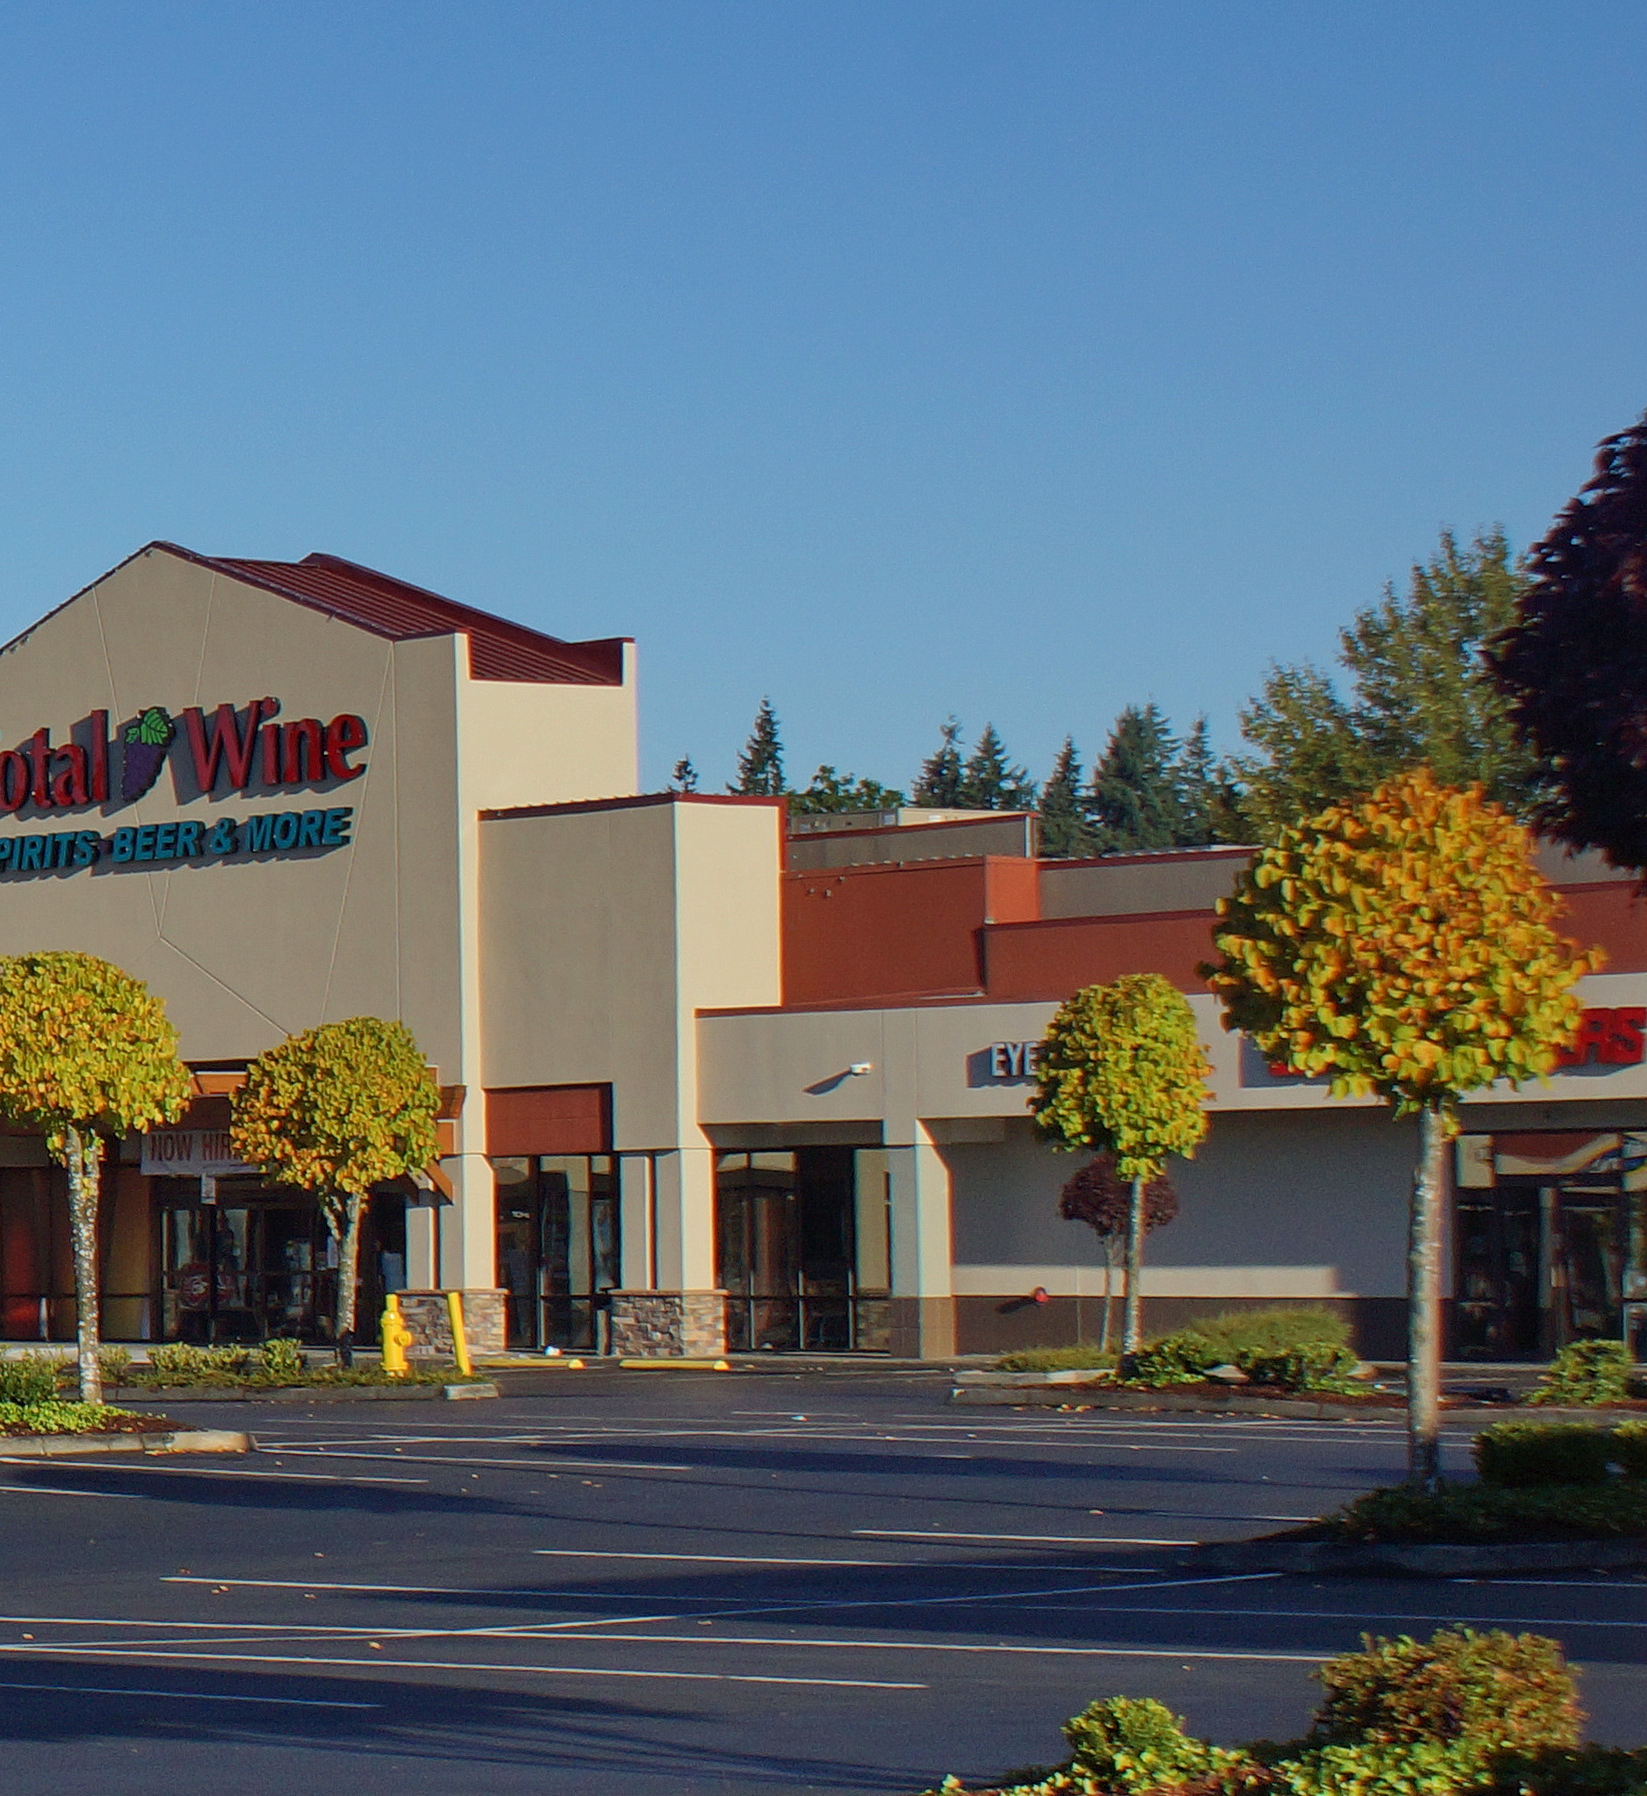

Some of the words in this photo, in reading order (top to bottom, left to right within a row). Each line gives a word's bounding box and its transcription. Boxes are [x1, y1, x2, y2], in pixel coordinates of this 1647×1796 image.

[182, 696, 369, 793] Wine
[209, 816, 239, 856] &
[245, 805, 355, 854] MORE
[150, 1133, 193, 1162] NOW
